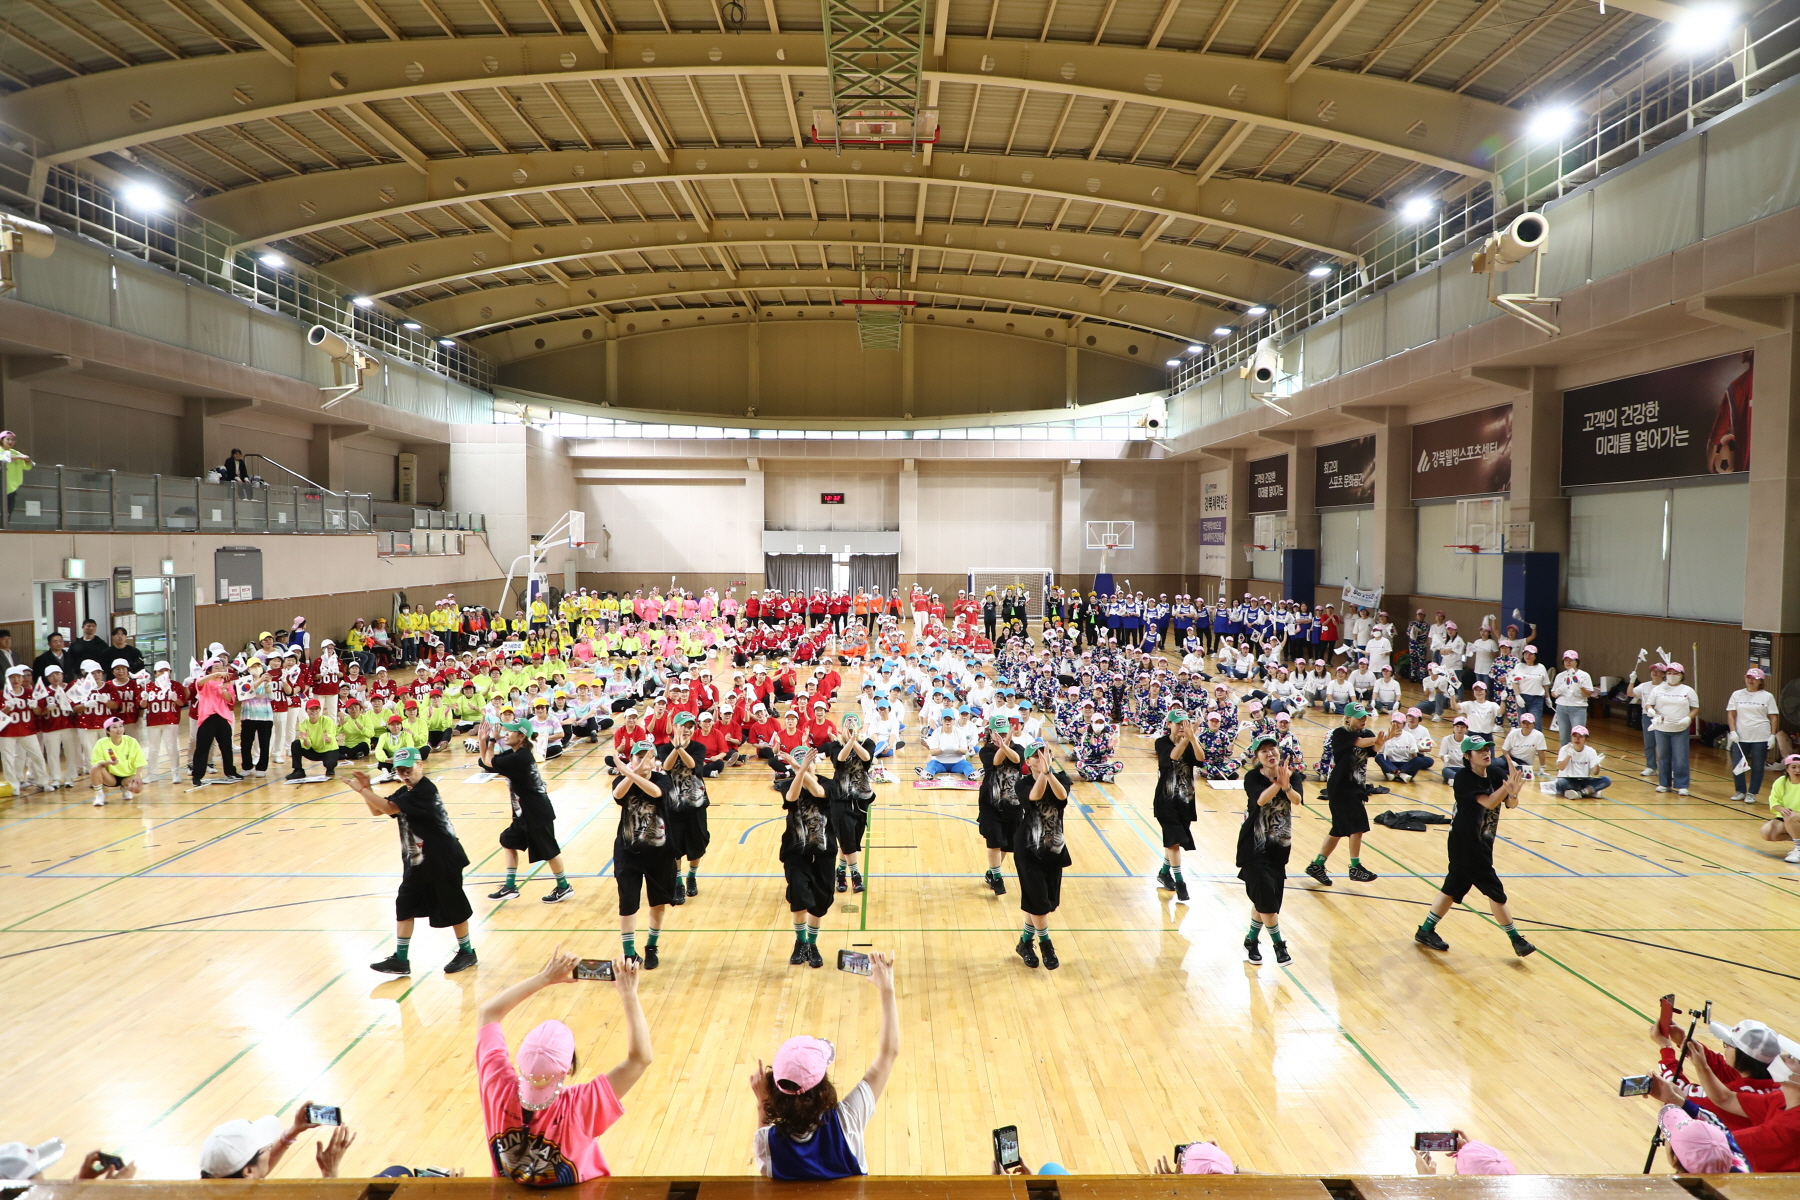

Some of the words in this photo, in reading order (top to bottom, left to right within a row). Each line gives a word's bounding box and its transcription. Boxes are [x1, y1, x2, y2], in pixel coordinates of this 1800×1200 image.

[1582, 408, 1618, 432] 고객의
[1621, 401, 1660, 427] 건강한
[1596, 432, 1632, 455] 미래를
[1635, 425, 1690, 452] 열어가는
[1323, 460, 1338, 474] 최고의
[1431, 442, 1498, 468] 강북웰빙스포츠센터
[1329, 475, 1343, 489] 스포츠
